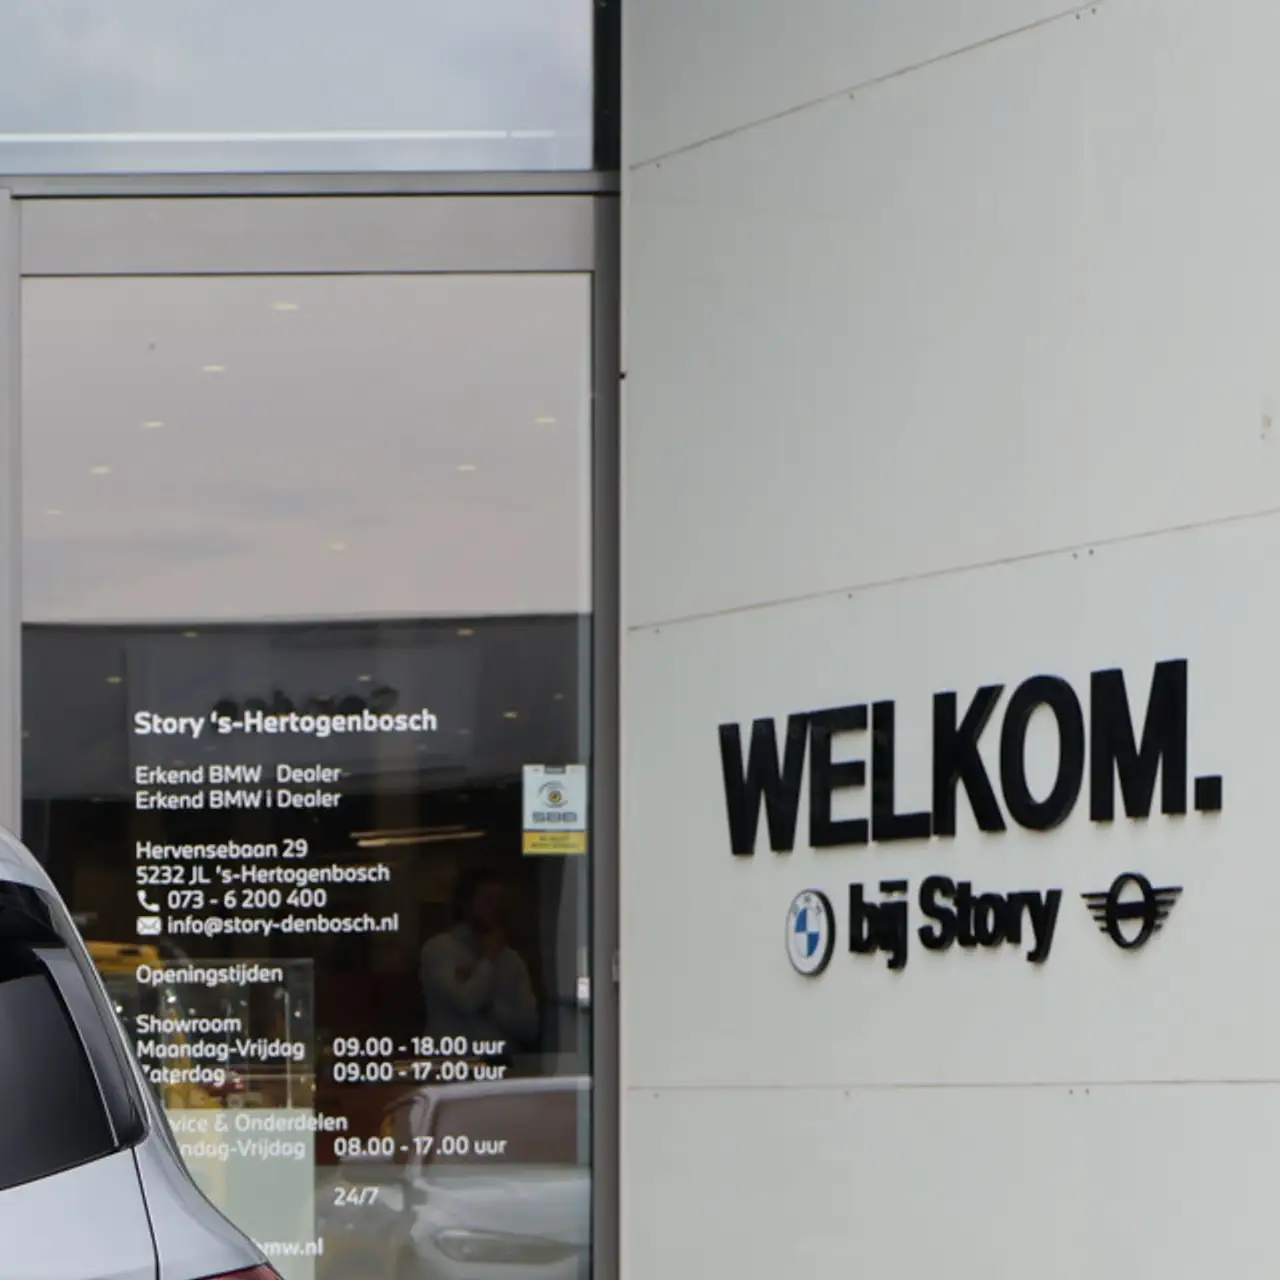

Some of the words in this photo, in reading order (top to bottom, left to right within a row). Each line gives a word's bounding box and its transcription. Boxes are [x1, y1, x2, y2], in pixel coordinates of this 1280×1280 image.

[134, 712, 204, 738] Story
[210, 710, 437, 735] 's-Hertogenbosch
[718, 658, 1223, 856] WELKOM.
[135, 766, 204, 784] Erkend
[208, 765, 262, 783] BMW
[276, 764, 341, 783] Dealer
[135, 792, 204, 809] Erkend
[208, 791, 262, 808] BMW
[267, 792, 272, 808] i
[276, 790, 341, 808] Dealer
[136, 840, 277, 860] Hervensebaan
[282, 839, 307, 858] 29
[136, 866, 185, 885] 5232
[189, 866, 211, 885] JL
[215, 864, 390, 887] 's-Hertogenbosch
[168, 890, 204, 909] 073
[223, 890, 237, 908] 6
[241, 890, 281, 908] 200
[286, 889, 327, 908] 400
[168, 913, 398, 937] info@story-denbosch.nl
[848, 879, 909, 970] bij
[917, 875, 1063, 964] Story
[136, 965, 283, 987] Openingstijden
[136, 1014, 241, 1034] Showroom
[136, 1039, 305, 1062] Maandag-Vrijdag
[333, 1038, 392, 1057] 09.00
[411, 1037, 466, 1056] 18.00
[471, 1040, 505, 1055] uur
[333, 1063, 392, 1082] 09.00
[471, 1065, 505, 1080] uur
[214, 1113, 229, 1133] &
[234, 1113, 347, 1132] Onderdelen
[181, 1139, 305, 1162] ndag-Vrijdag
[334, 1137, 395, 1156] 08.00
[475, 1139, 506, 1155] uur
[334, 1187, 379, 1208] 24/7
